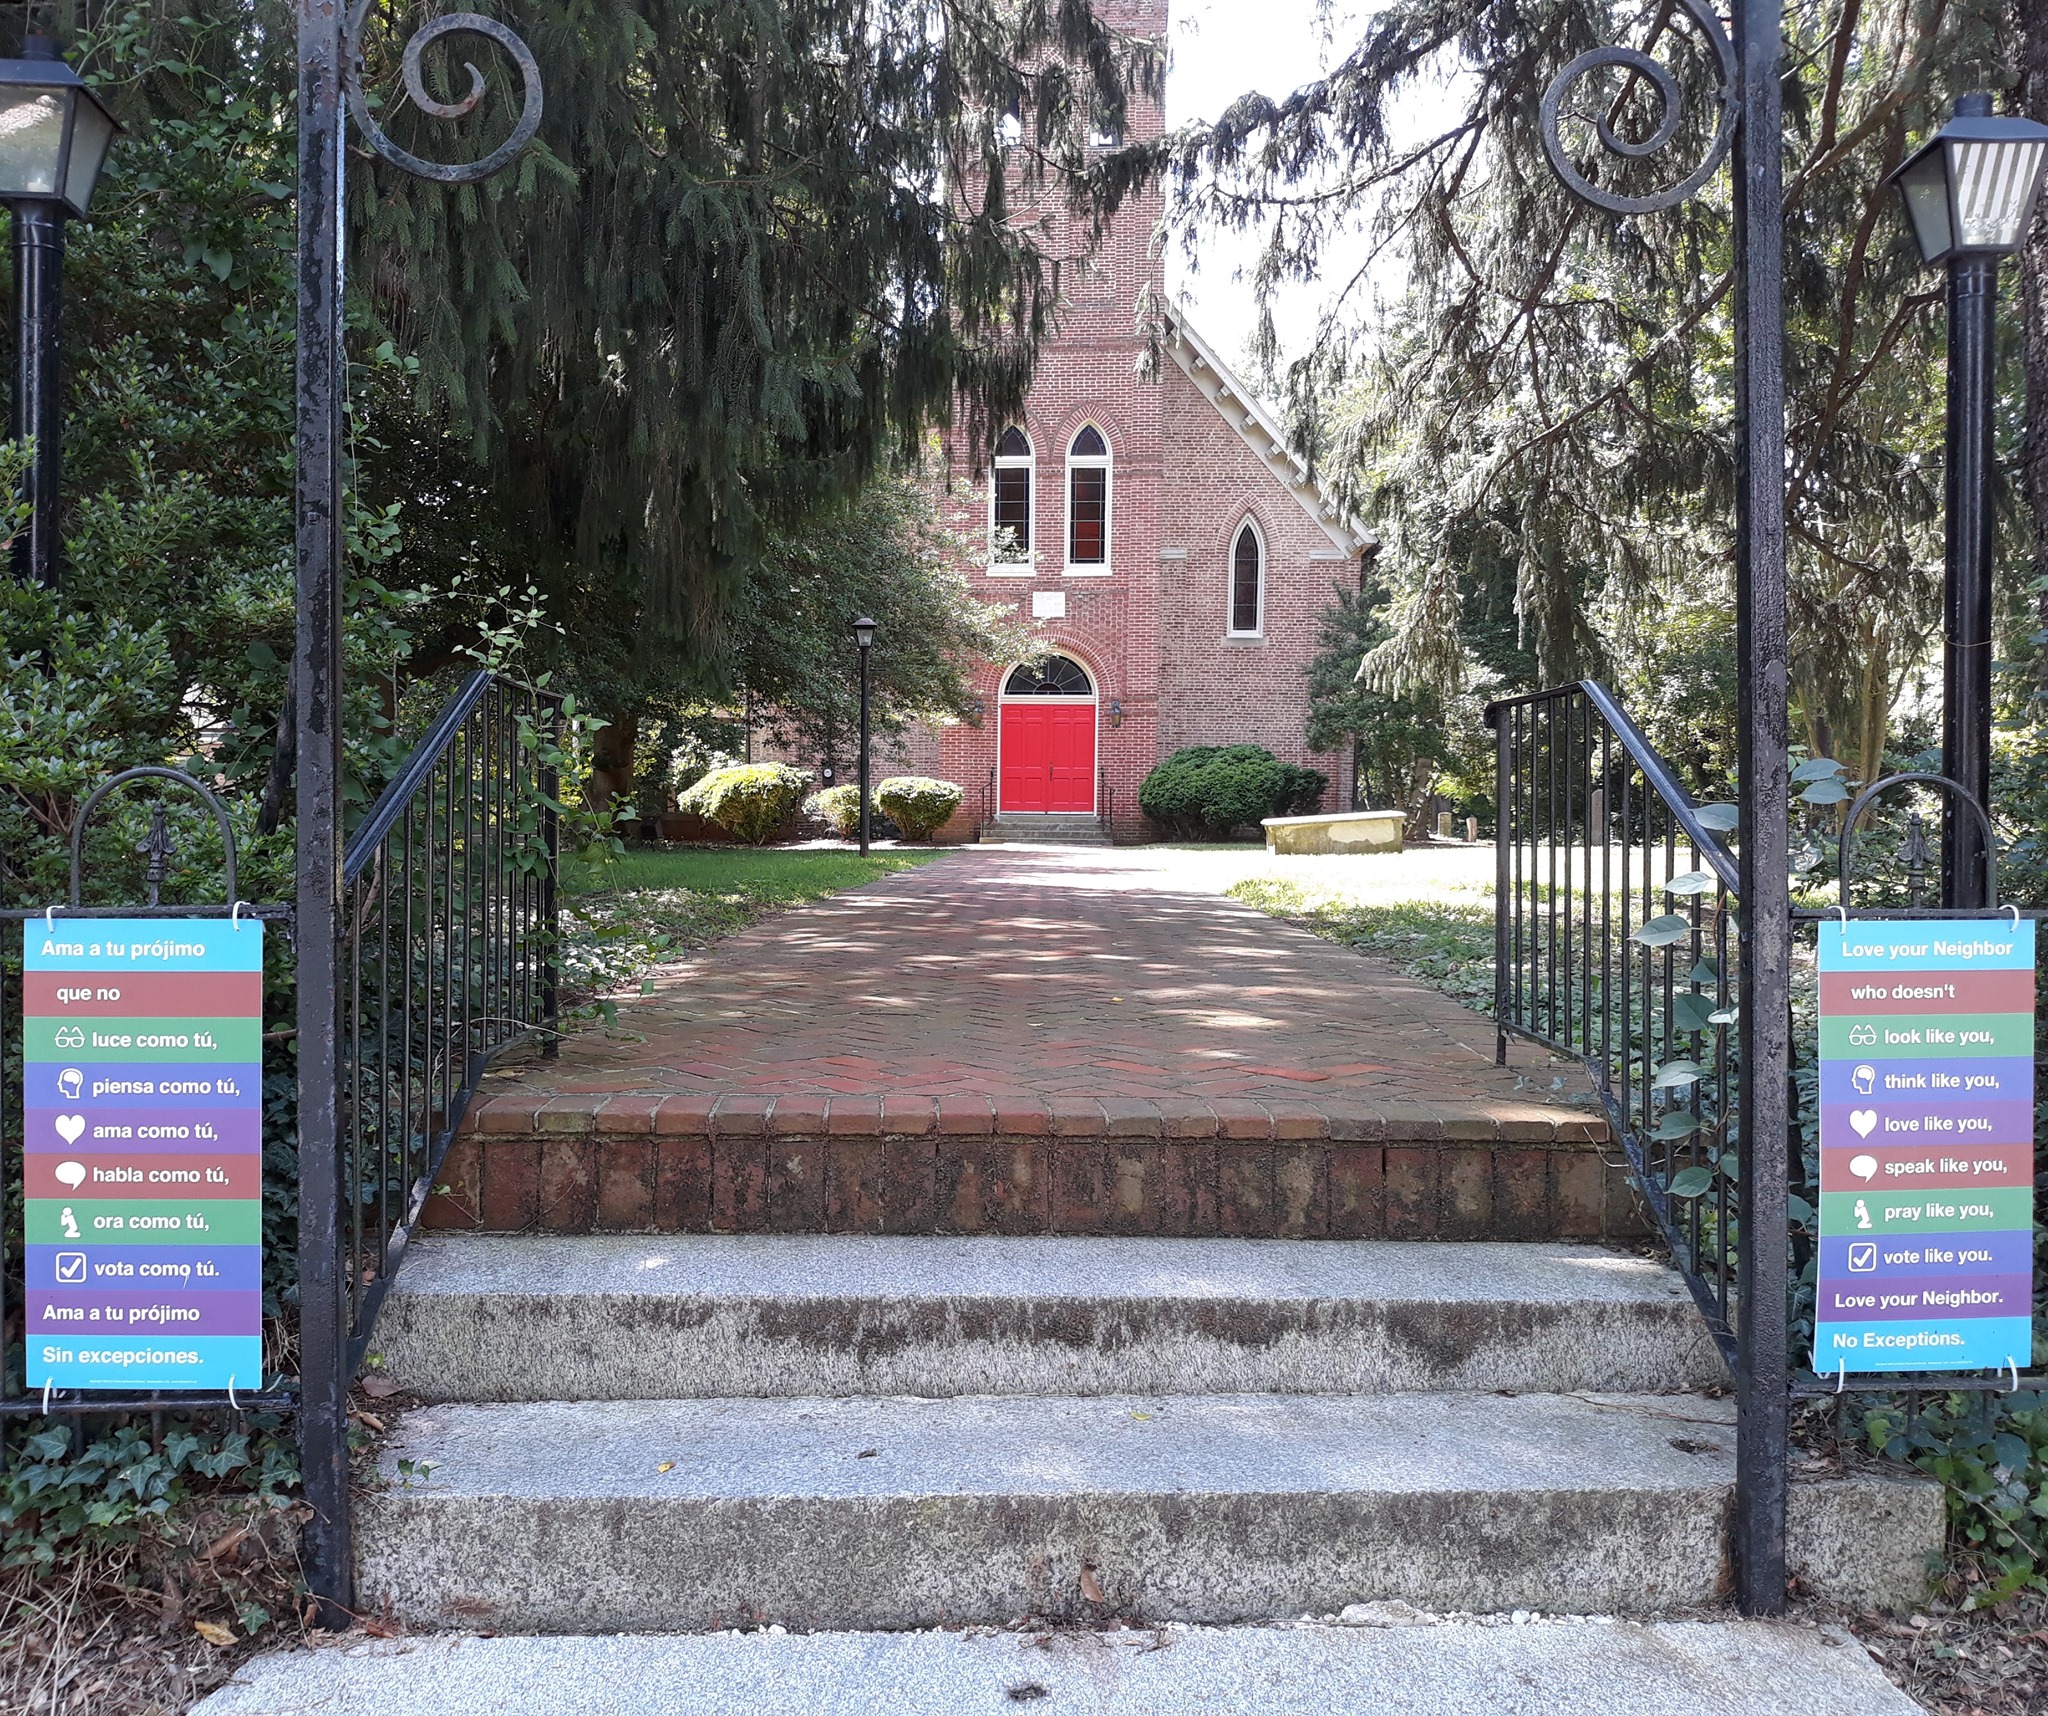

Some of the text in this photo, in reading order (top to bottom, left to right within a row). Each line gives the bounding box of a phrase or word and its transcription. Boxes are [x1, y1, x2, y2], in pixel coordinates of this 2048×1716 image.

[41, 940, 205, 960] Ama a tu prójimo
[1842, 941, 2013, 959] Love your Neighbor
[56, 988, 120, 1004] que no
[1851, 984, 1955, 999] who doesn't
[92, 1032, 217, 1050] luce como tú,
[1885, 1029, 1994, 1046] look like you,
[93, 1078, 240, 1098] piensa como tú,
[1884, 1073, 1999, 1090] think like you,
[93, 1123, 218, 1141] ama como tú,
[1885, 1116, 1992, 1133] love like you,
[93, 1167, 229, 1185] habla como tú,
[1885, 1158, 2007, 1177] speak like you,
[1884, 1203, 1993, 1222] pray like you,
[94, 1213, 209, 1232] ora como tú,
[1884, 1248, 1992, 1265] vote like you.
[94, 1261, 220, 1276] vota como tú.
[1835, 1290, 2003, 1310] Love your Neighbor.
[43, 1304, 200, 1324] Ama a tu prójimo
[1833, 1332, 1965, 1349] No Exceptions.
[43, 1347, 203, 1367] Sin excepciones.
